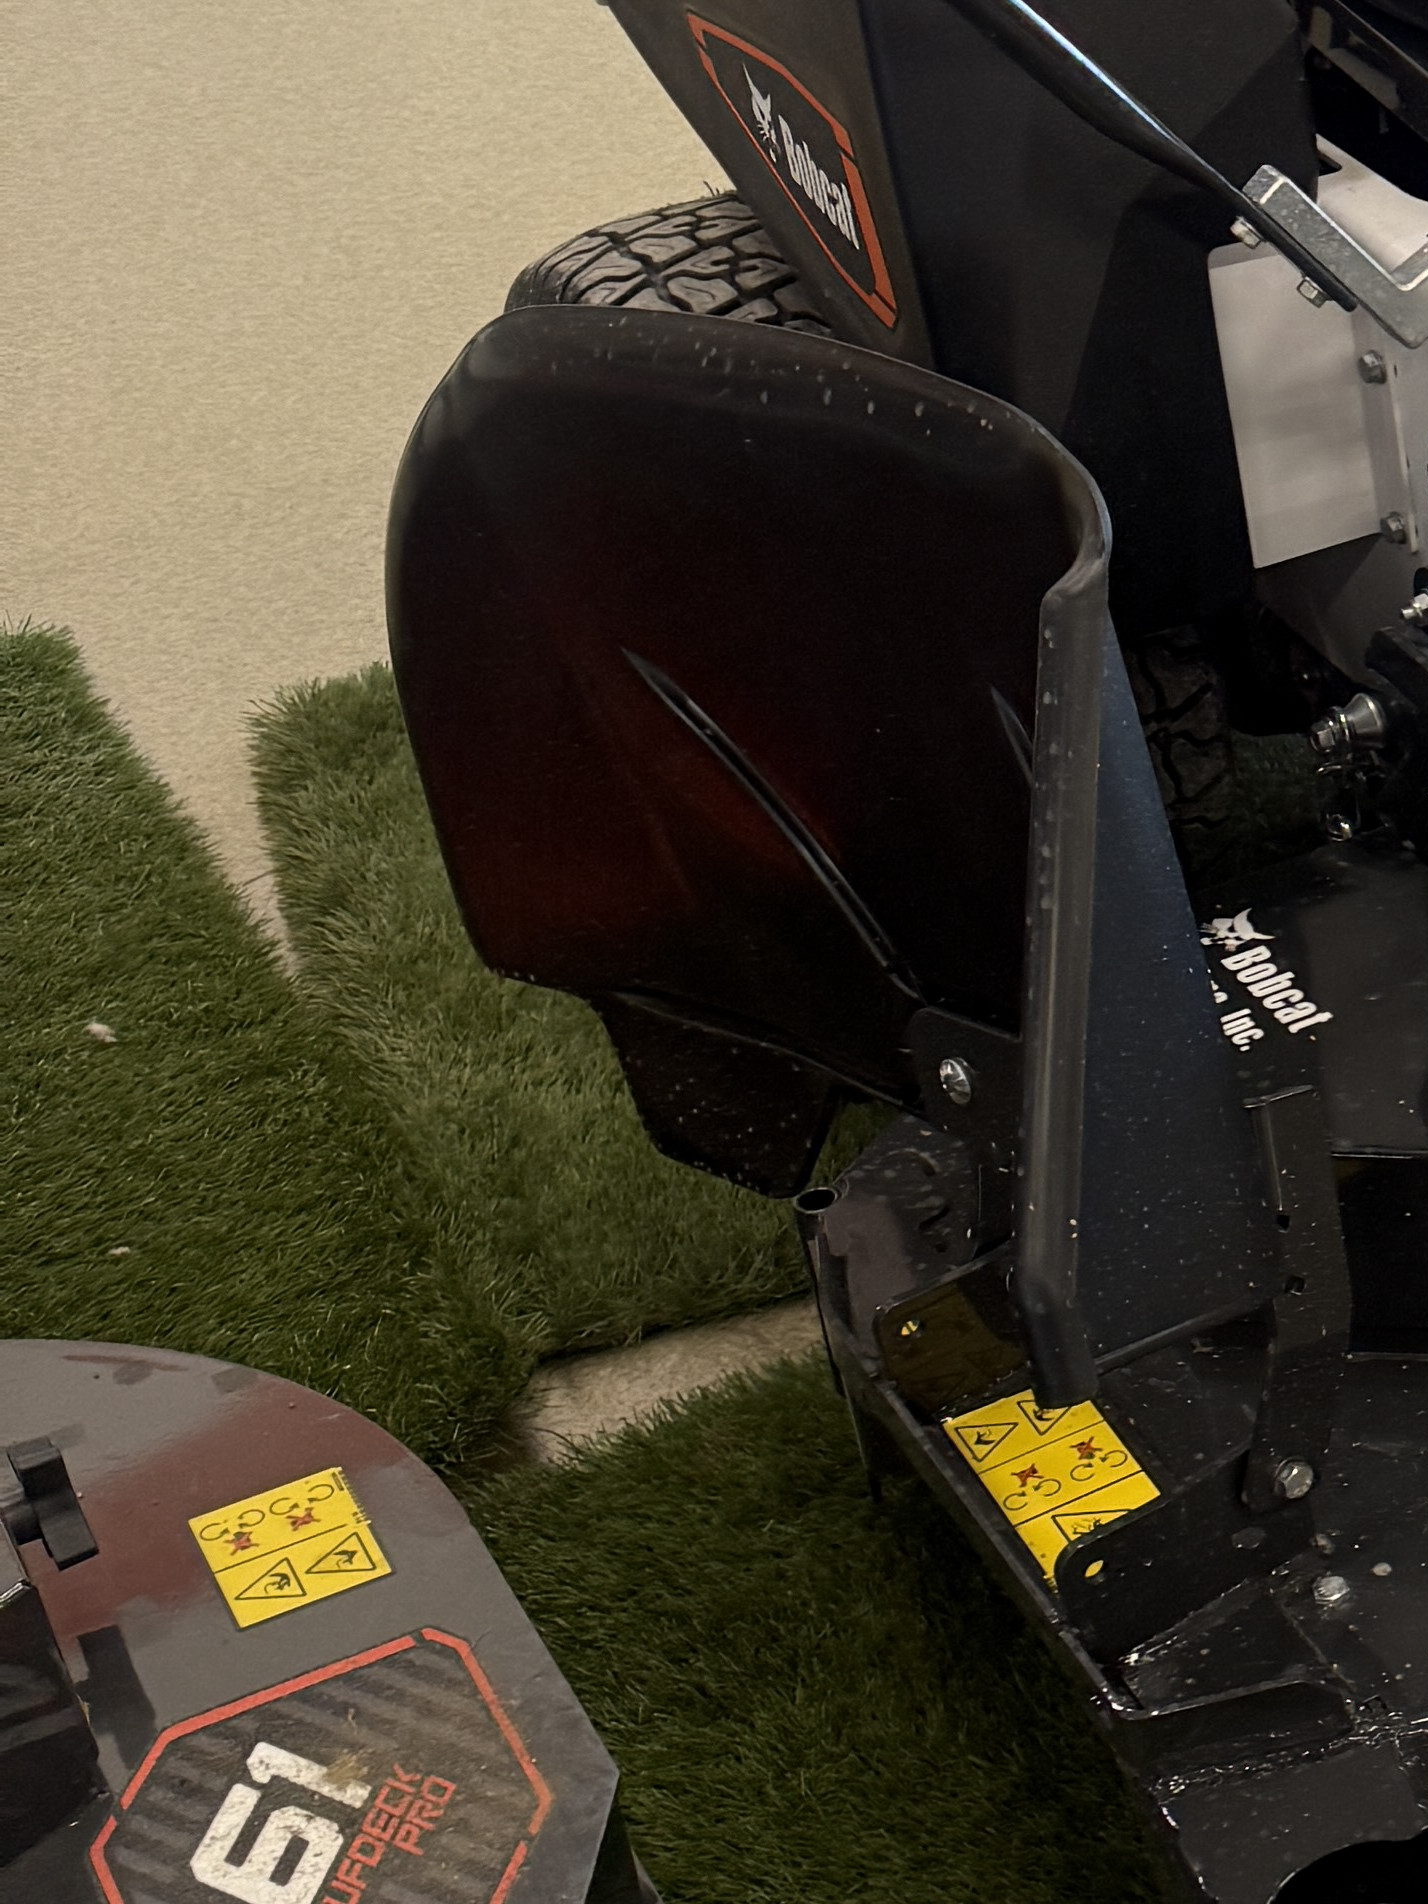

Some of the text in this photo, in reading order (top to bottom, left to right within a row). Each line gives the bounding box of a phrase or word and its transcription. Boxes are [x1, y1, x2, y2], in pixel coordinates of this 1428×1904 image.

[778, 114, 860, 251] Bobcat
[1220, 945, 1333, 1033] Bobcat
[1220, 1008, 1264, 1052] Inc.
[394, 1774, 457, 1856] PRO
